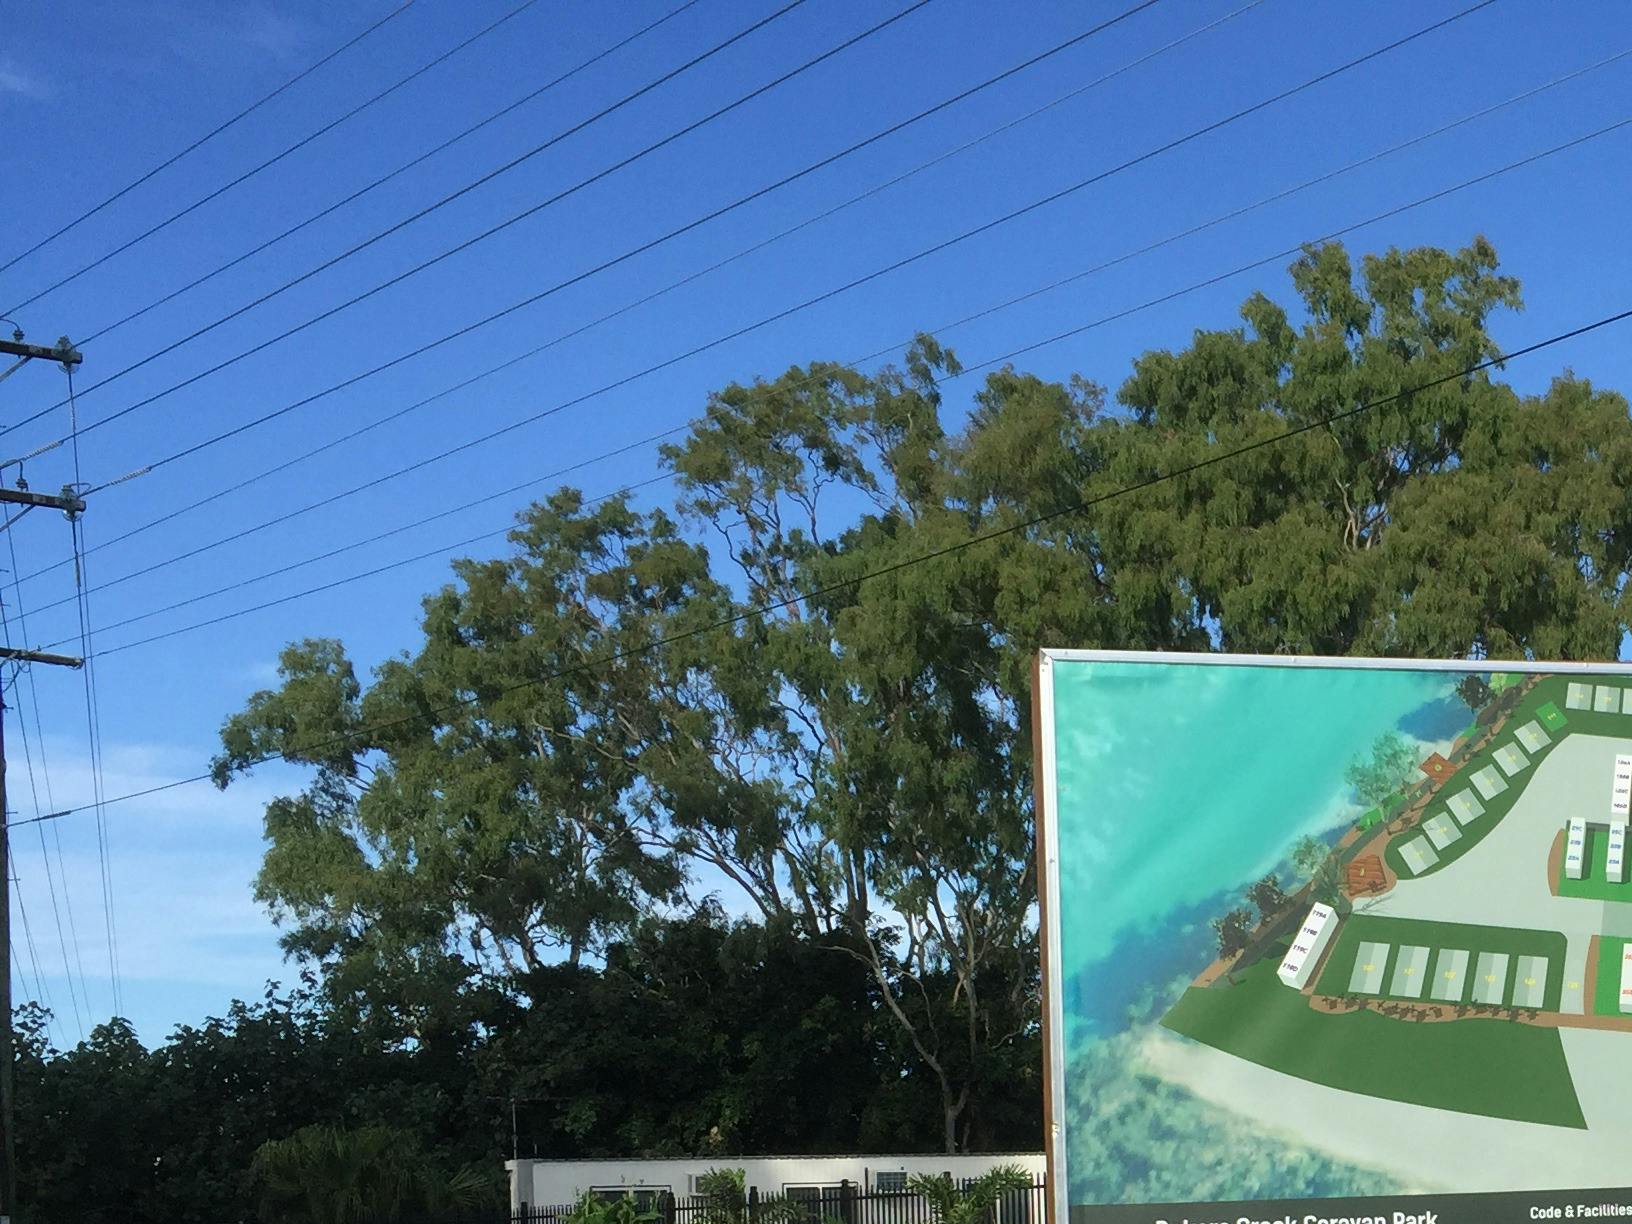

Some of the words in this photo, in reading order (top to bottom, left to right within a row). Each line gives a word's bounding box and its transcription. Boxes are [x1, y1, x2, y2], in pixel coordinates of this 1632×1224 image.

[1530, 1206, 1561, 1219] Code
[1565, 1205, 1574, 1218] &
[1577, 1204, 1632, 1217] Facilities
